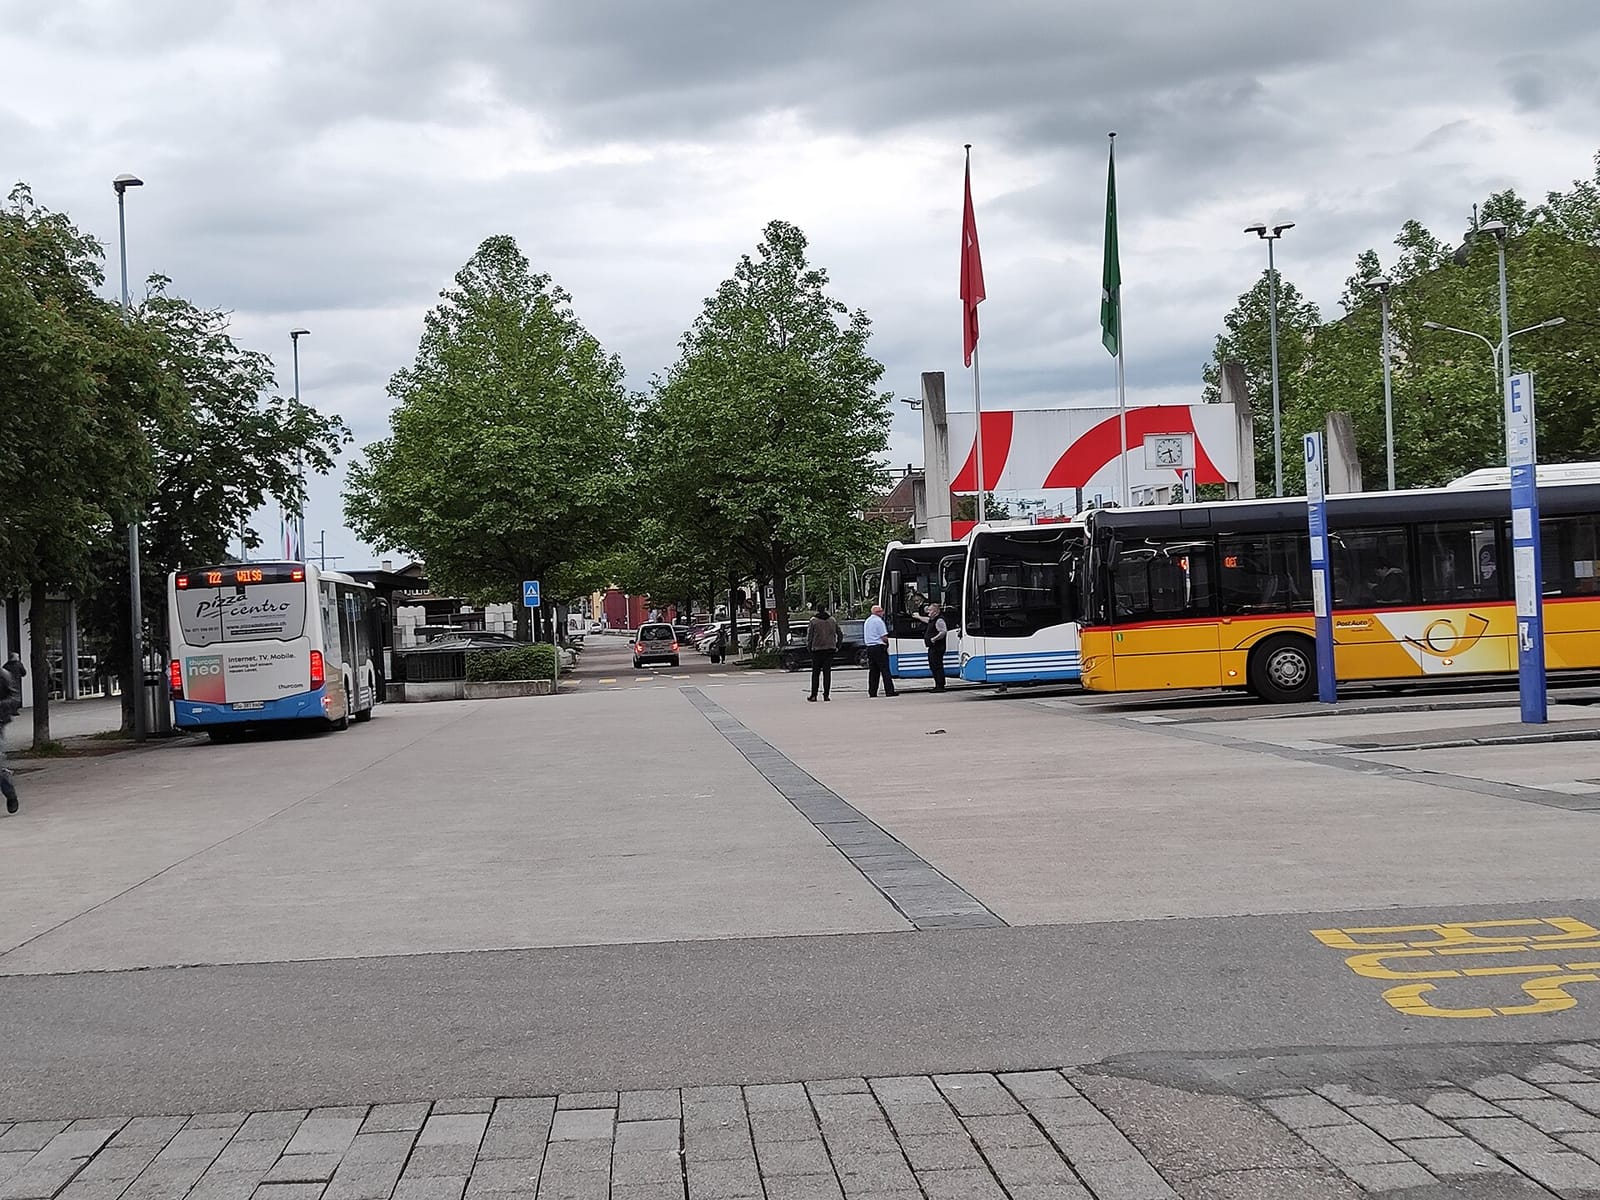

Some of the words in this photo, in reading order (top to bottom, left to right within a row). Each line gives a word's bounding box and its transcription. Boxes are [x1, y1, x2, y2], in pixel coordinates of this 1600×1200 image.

[1510, 379, 1521, 413] E
[1306, 436, 1315, 462] D
[1183, 472, 1189, 494] C
[207, 572, 222, 584] 722
[766, 587, 774, 598] P
[230, 599, 291, 616] centro
[189, 665, 220, 676] neo
[1309, 916, 1600, 1019] BUS
